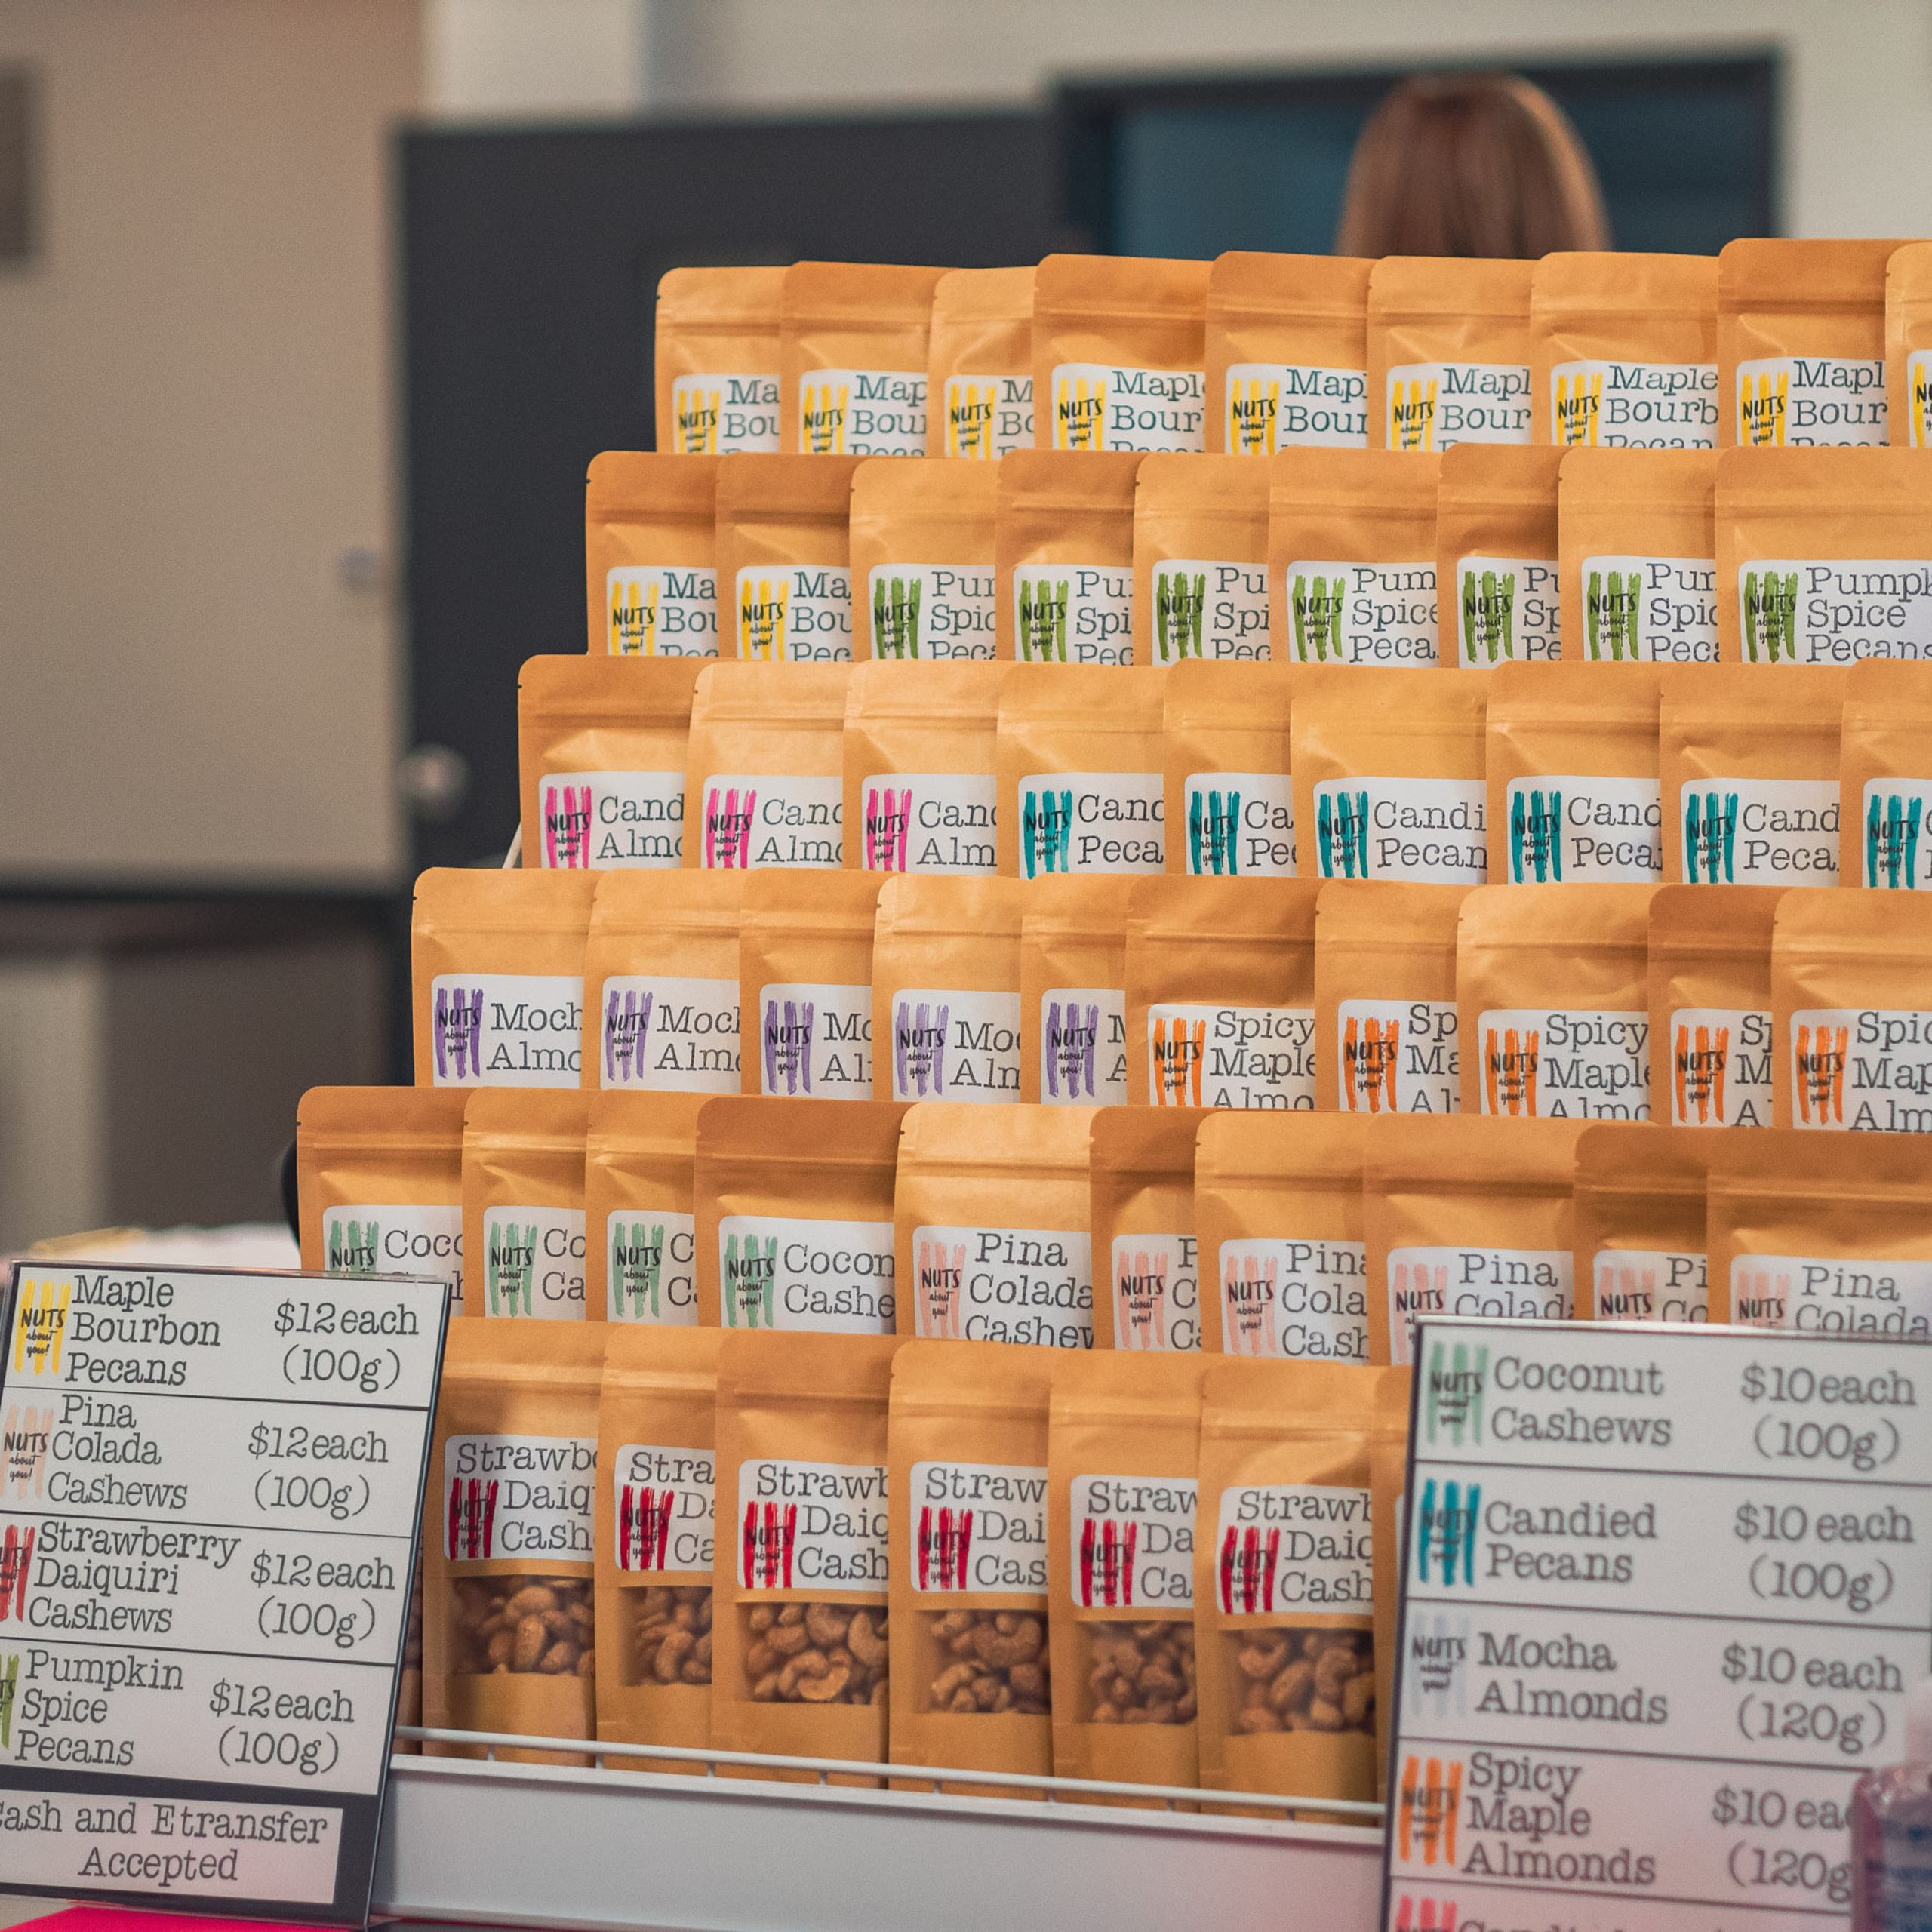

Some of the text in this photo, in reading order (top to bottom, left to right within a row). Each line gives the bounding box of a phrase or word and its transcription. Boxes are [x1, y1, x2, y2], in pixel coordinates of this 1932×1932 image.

[1113, 371, 1205, 401] Mapl
[1607, 365, 1718, 396] Maple
[1060, 399, 1101, 423] NUTS
[1111, 405, 1204, 432] Bour
[1233, 399, 1275, 418] NUTS
[1395, 402, 1432, 425] NUTS
[1558, 396, 1598, 420] NUTS
[1743, 396, 1783, 422] NUTS
[1792, 401, 1887, 426] Bour
[1401, 421, 1426, 433] about
[1403, 435, 1421, 448] you!
[875, 603, 915, 625] NUTS
[1160, 595, 1203, 617] NUTS
[1297, 597, 1341, 617] NUTS
[1353, 598, 1438, 632] Spice
[1466, 595, 1510, 619] NUTS
[1589, 594, 1635, 614] NUTS
[1749, 594, 1795, 617] NUTS
[614, 607, 654, 626] NUTS
[1303, 616, 1336, 626] about
[1807, 600, 1906, 633] Spice
[620, 626, 648, 638] about
[1307, 628, 1328, 645] you!
[623, 639, 643, 654] you!
[1349, 636, 1439, 663] Peca
[548, 812, 589, 832] NUTS
[709, 814, 750, 832] NUTS
[1320, 814, 1365, 840] NUTS
[1515, 814, 1559, 838] NUTS
[1687, 816, 1733, 841] NUTS
[1869, 820, 1915, 841] NUTS
[555, 832, 584, 844] about
[1522, 834, 1555, 851] about
[558, 845, 579, 860] you!
[1525, 848, 1549, 866] you!
[1571, 837, 1663, 868] Peca
[1744, 841, 1839, 872] Peca
[438, 1008, 479, 1028] NUTS
[608, 1013, 646, 1035] NUTS
[1215, 1011, 1315, 1046] Spicy
[445, 1028, 475, 1041] about
[768, 1025, 809, 1045] NUTS
[900, 1029, 944, 1049] NUTS
[1051, 1028, 1095, 1048] NUTS
[1546, 1014, 1648, 1055] Spicy
[448, 1038, 467, 1056] you!
[907, 1050, 937, 1061] about
[1155, 1041, 1199, 1060] NUTS
[910, 1063, 931, 1078] you!
[1210, 1047, 1315, 1084] Maple
[1491, 1053, 1537, 1072] NUTS
[1799, 1053, 1842, 1074] NUTS
[331, 1247, 374, 1268] NUTS
[491, 1247, 532, 1266] NUTS
[617, 1247, 660, 1266] NUTS
[975, 1233, 1068, 1266] Pina
[729, 1258, 774, 1279] NUTS
[922, 1269, 959, 1288] NUTS
[1460, 1254, 1558, 1287] Pina
[72, 1275, 174, 1312] Maple
[737, 1279, 768, 1291] about
[970, 1274, 1093, 1310] Colada
[1121, 1275, 1163, 1296] NUTS
[1229, 1281, 1273, 1302] NUTS
[1801, 1266, 1900, 1302] Pina
[740, 1294, 761, 1309] you!
[929, 1291, 952, 1301] about
[1397, 1290, 1443, 1311] NUTS
[1601, 1294, 1651, 1315] NUTS
[22, 1309, 64, 1327] NUTS
[933, 1305, 948, 1319] you!
[1740, 1299, 1783, 1318] NUTS
[26, 1328, 57, 1340] about
[71, 1312, 220, 1346] Bourbon
[27, 1344, 50, 1358] you!
[65, 1352, 186, 1386] Pecans
[284, 1344, 400, 1393] (100g)
[1494, 1356, 1663, 1396] Coconut
[1431, 1372, 1481, 1394] NUTS
[59, 1395, 137, 1428] Pina
[1491, 1407, 1671, 1447] Cashews
[5, 1432, 48, 1452] NUTS
[53, 1431, 162, 1465] Colada
[1755, 1414, 1900, 1472] (100g)
[9, 1454, 40, 1465] about
[10, 1469, 32, 1482] you!
[48, 1472, 187, 1509] Cashews
[255, 1470, 369, 1520] (100g)
[1485, 1501, 1657, 1539] Candied
[38, 1521, 241, 1569] Strawberry
[1487, 1543, 1632, 1583] Pecans
[34, 1557, 178, 1597] Daiquiri
[1750, 1554, 1894, 1614] (100g)
[29, 1597, 172, 1632] Cashews
[259, 1596, 375, 1648] (100g)
[1412, 1635, 1465, 1659] NUTS
[1478, 1632, 1617, 1672] Mocha
[25, 1649, 183, 1690] Pumpkin
[21, 1688, 107, 1727] Spice
[1475, 1680, 1668, 1725] Almonds
[1738, 1695, 1886, 1755] (120g)
[15, 1730, 134, 1766] Pecans
[219, 1726, 338, 1775] (100g)
[1468, 1751, 1581, 1803] Spicy
[0, 1800, 62, 1832] ash
[75, 1802, 136, 1834] and
[1467, 1797, 1591, 1843] Maple
[78, 1847, 237, 1887] Accepted
[1462, 1842, 1656, 1884] Almonds
